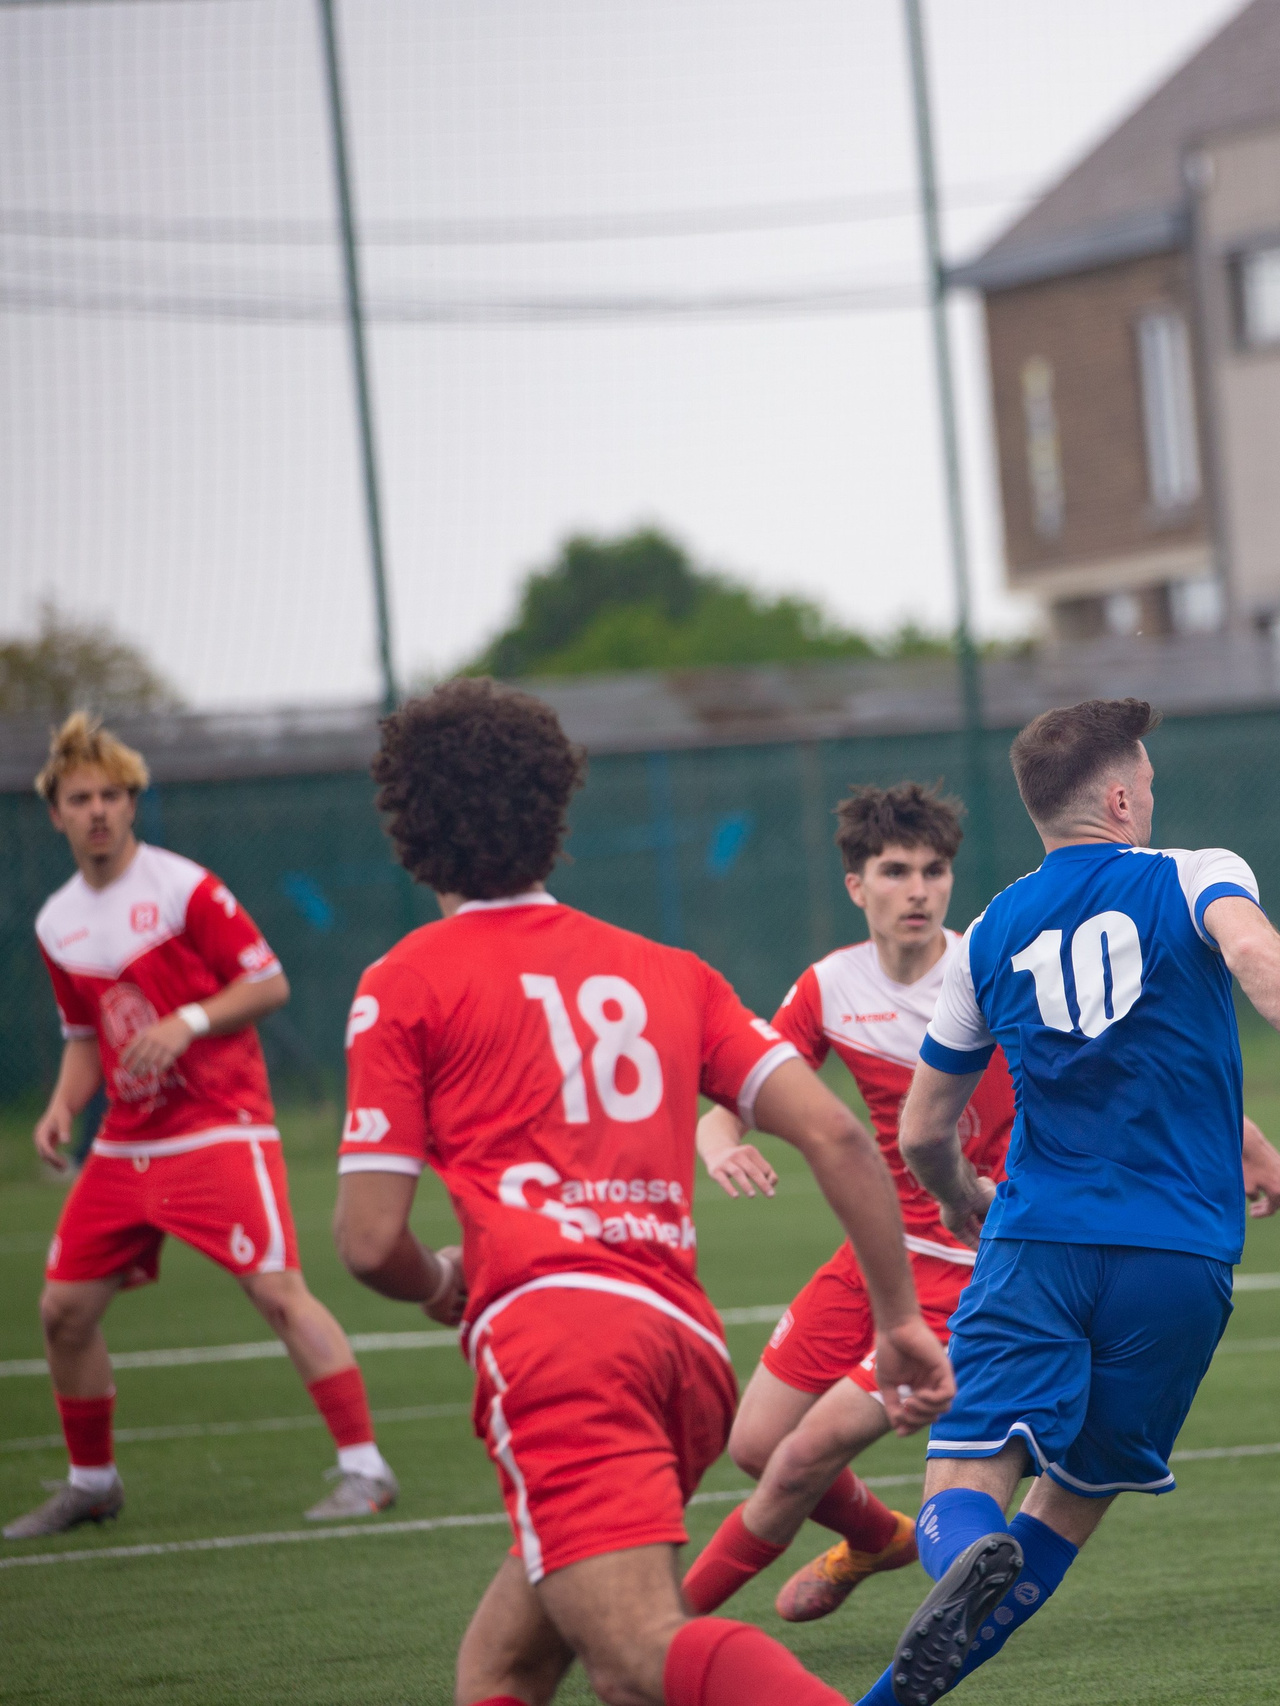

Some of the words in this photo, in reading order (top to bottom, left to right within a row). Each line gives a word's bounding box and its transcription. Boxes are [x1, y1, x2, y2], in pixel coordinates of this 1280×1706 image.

[1011, 910, 1143, 1039] 10
[520, 973, 664, 1124] 18
[230, 1222, 256, 1265] 6
